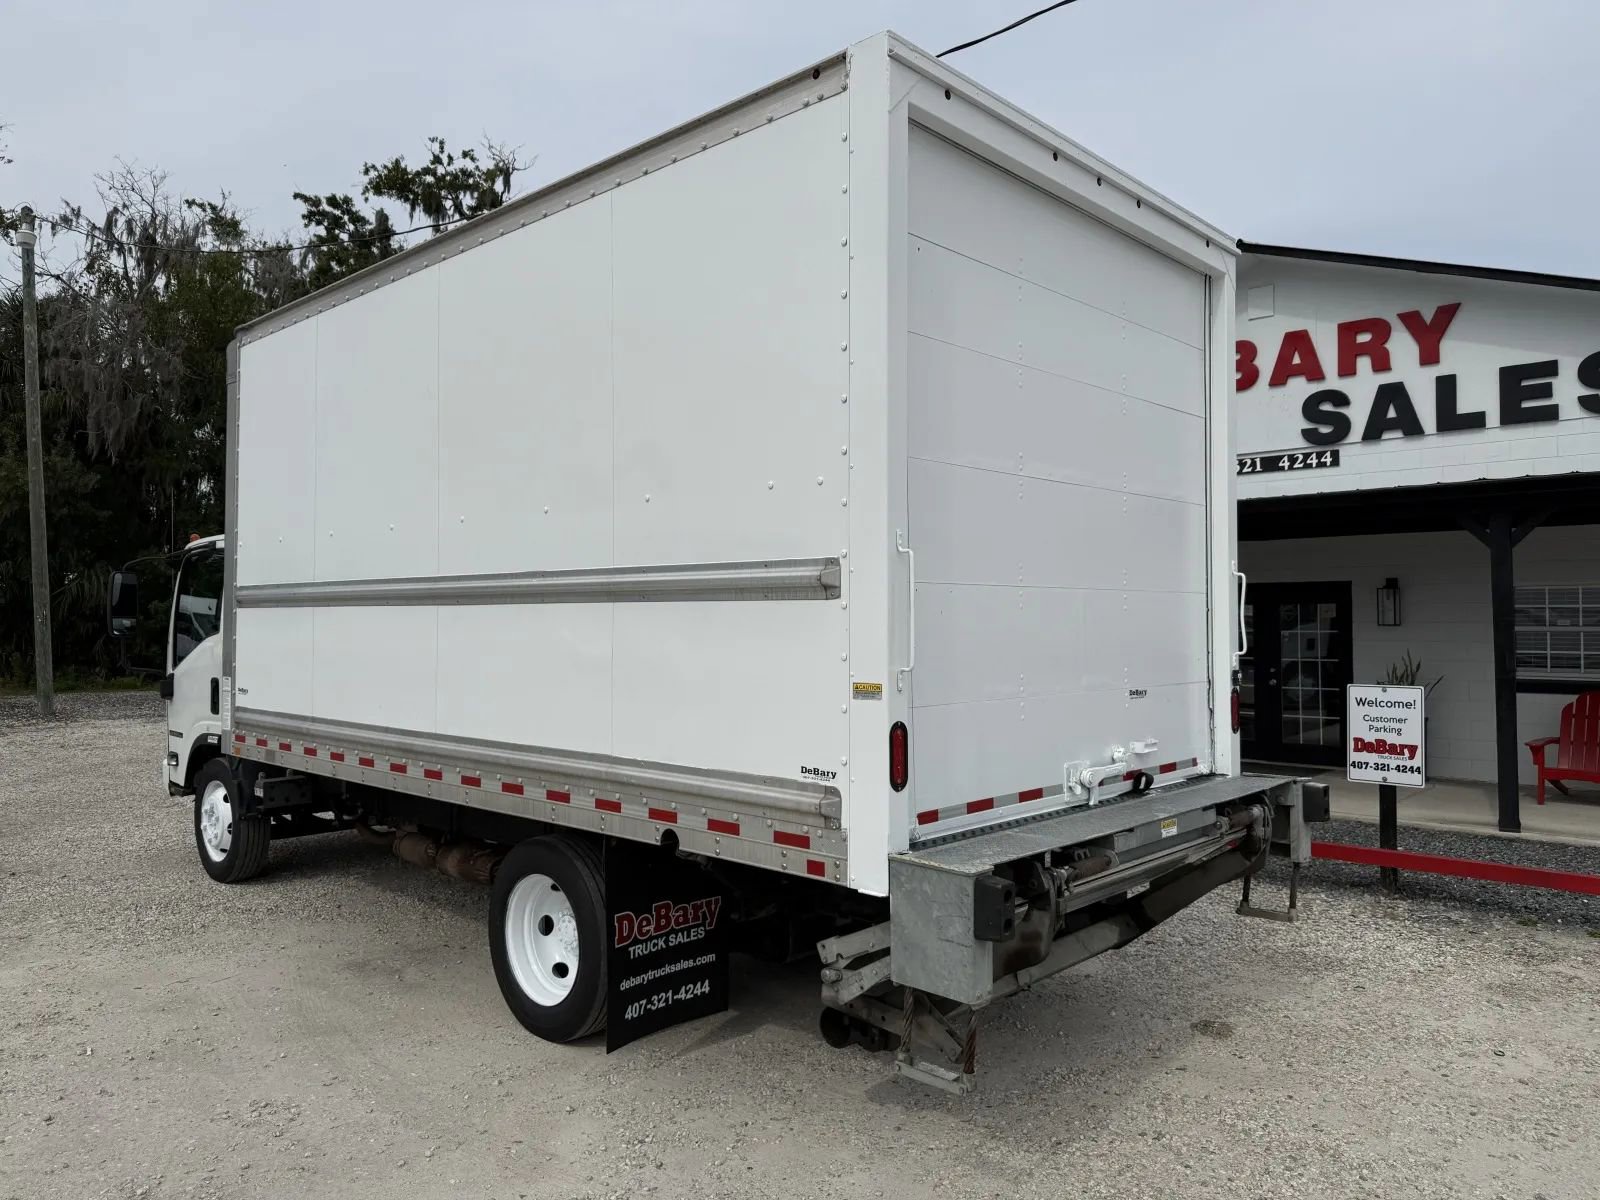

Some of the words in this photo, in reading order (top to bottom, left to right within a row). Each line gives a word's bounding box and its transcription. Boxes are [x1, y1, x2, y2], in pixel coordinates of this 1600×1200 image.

[1278, 450, 1333, 471] 4244
[1355, 697, 1417, 710] Welcome!
[1362, 714, 1408, 724] Customer
[1368, 724, 1402, 736] Parking
[1352, 737, 1418, 761] DeBary
[800, 765, 837, 780] DeBary
[1350, 760, 1422, 775] 407-321-4244
[614, 895, 722, 949] DeBary
[628, 935, 666, 960] TRUCK
[668, 926, 705, 947] SALES
[620, 953, 716, 991] debarytrucksales.com
[624, 978, 710, 1021] 407-321-4244
